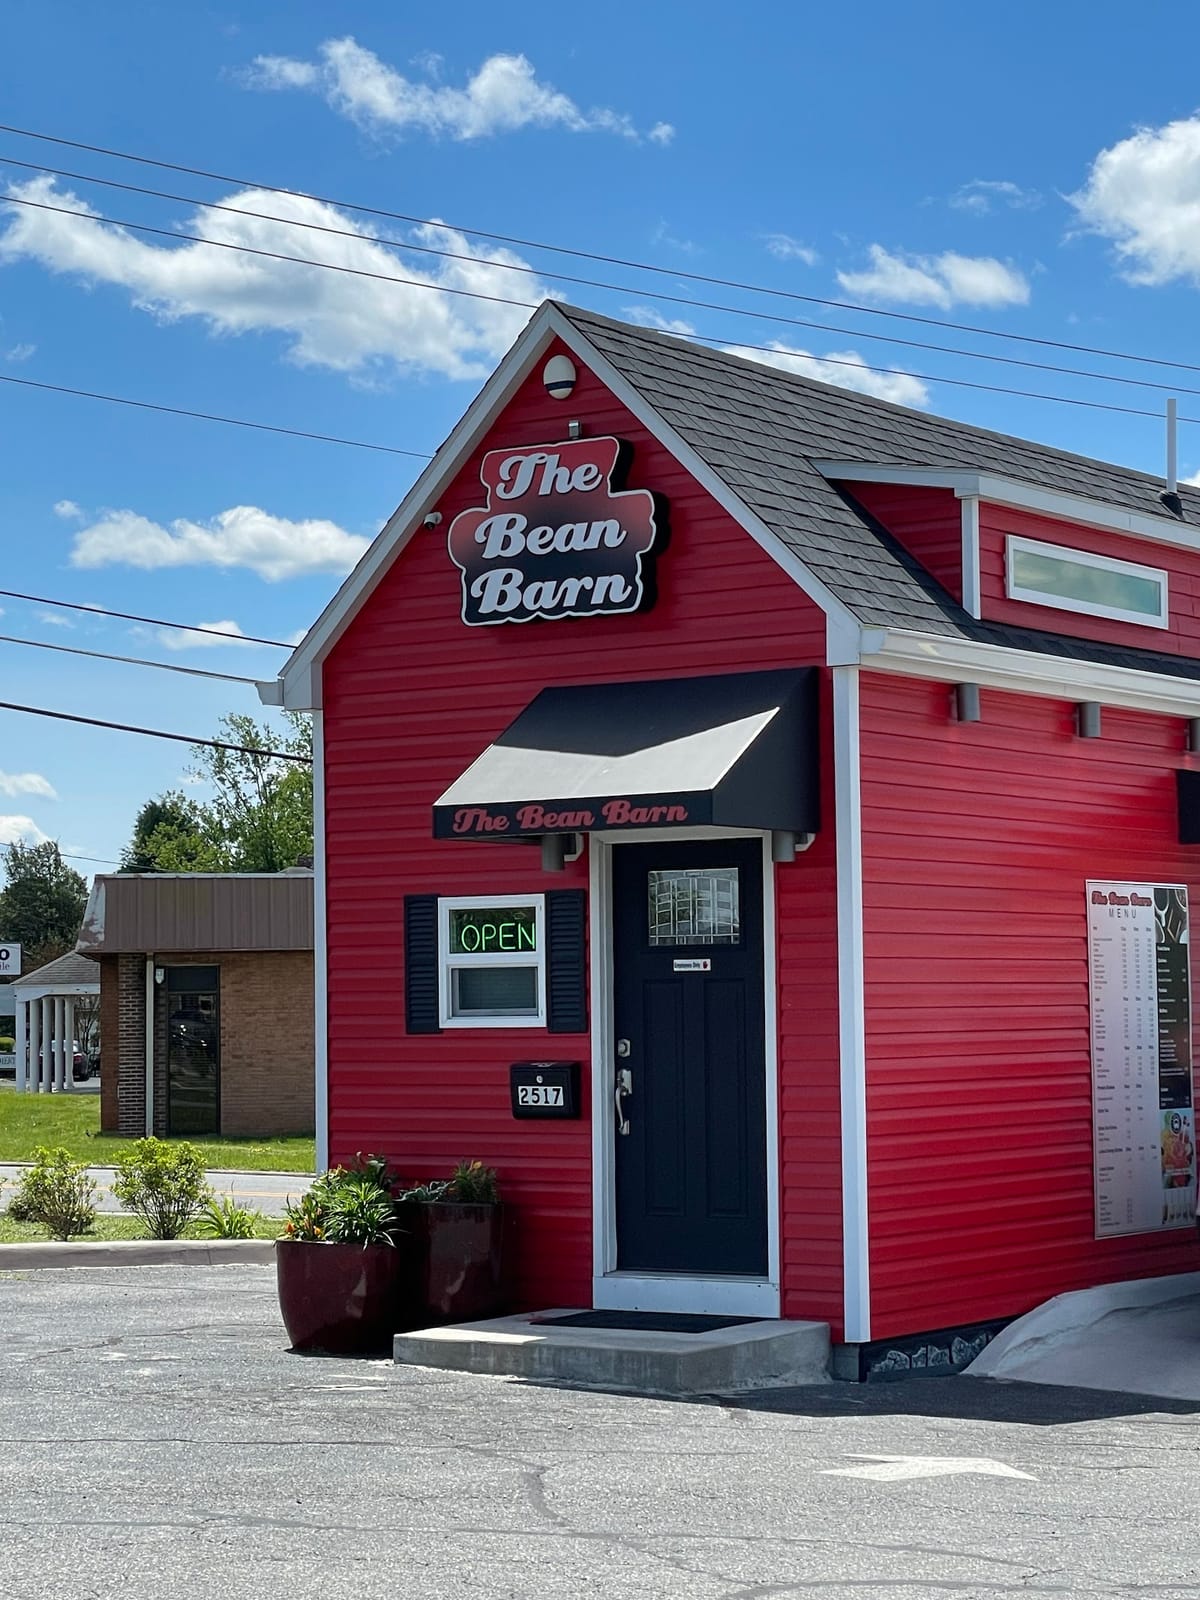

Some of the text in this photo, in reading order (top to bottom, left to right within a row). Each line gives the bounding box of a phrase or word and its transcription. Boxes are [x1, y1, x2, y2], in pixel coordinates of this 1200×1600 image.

[496, 453, 602, 500] The
[474, 513, 627, 559] Bean
[471, 568, 632, 614] Barn
[452, 800, 688, 833] The Bean Barn
[1109, 908, 1137, 919] MENU
[461, 922, 535, 951] OPEN
[520, 1088, 561, 1104] 2517
